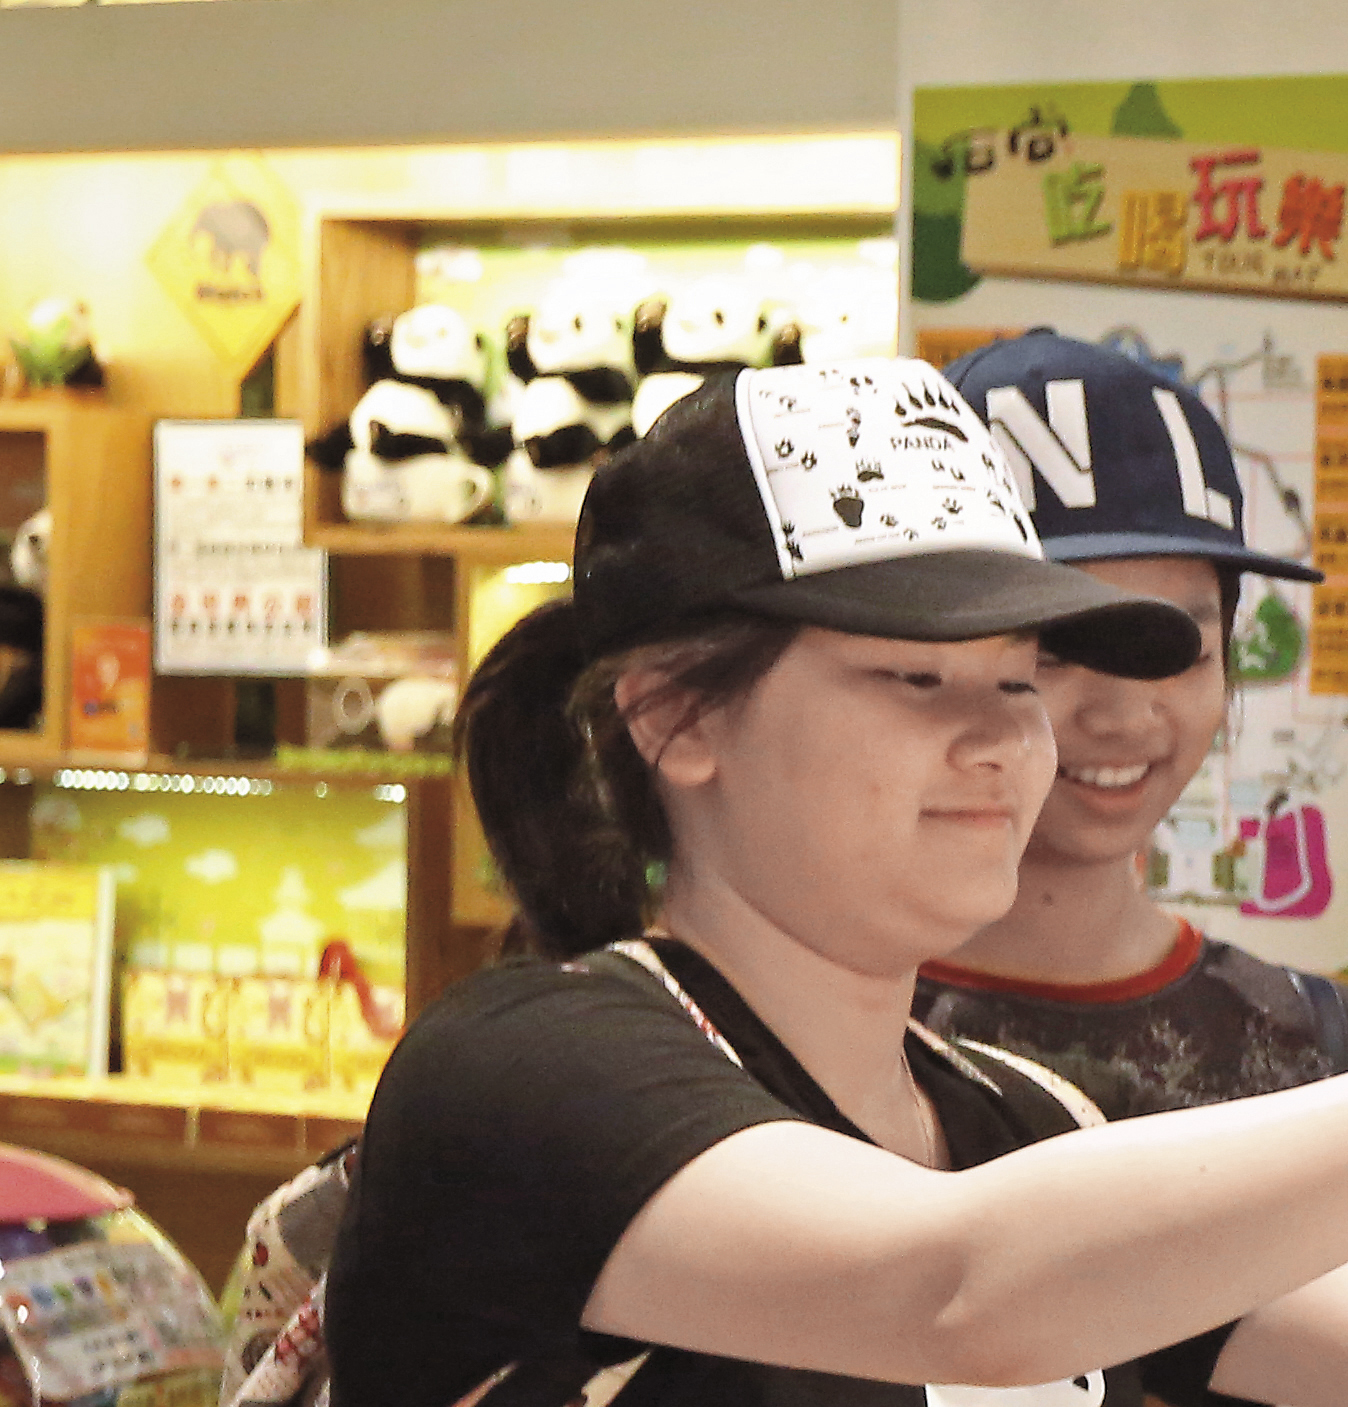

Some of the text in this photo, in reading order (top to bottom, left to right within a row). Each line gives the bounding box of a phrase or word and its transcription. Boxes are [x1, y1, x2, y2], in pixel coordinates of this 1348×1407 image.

[1043, 149, 1348, 280] 吃喝玩樂
[890, 435, 955, 453] PANDA
